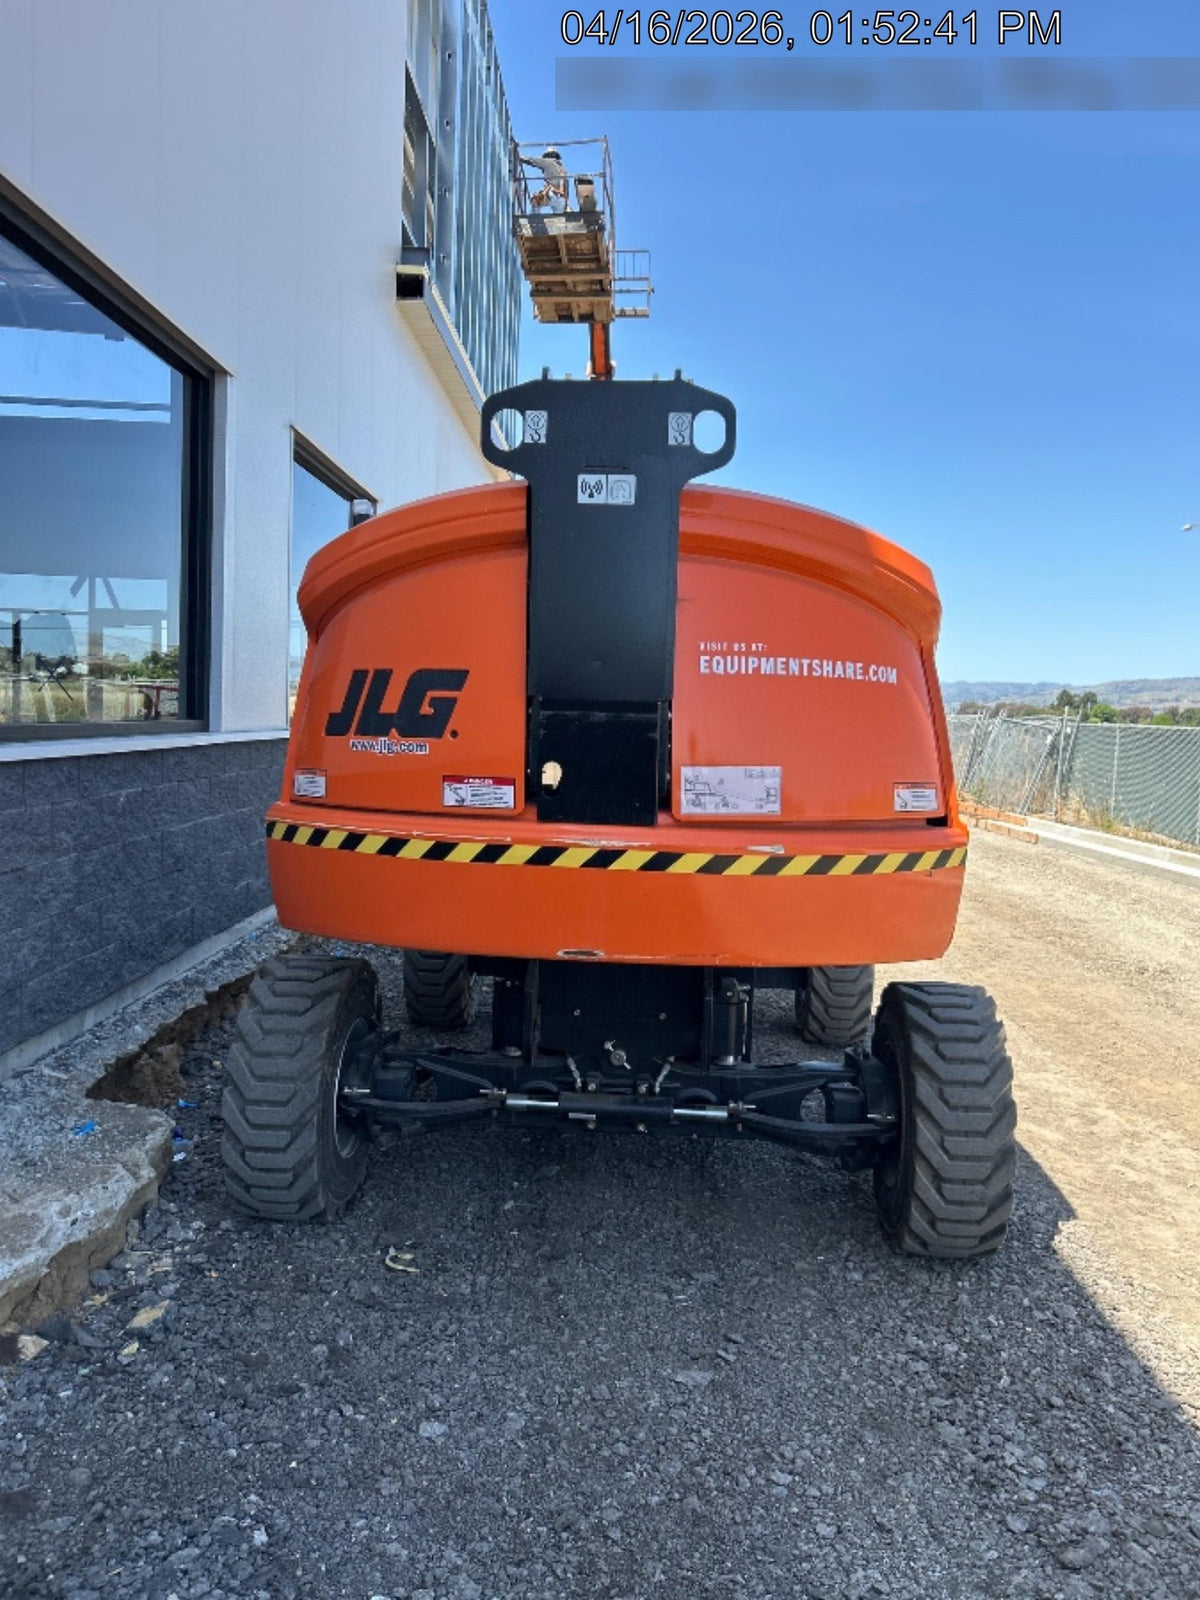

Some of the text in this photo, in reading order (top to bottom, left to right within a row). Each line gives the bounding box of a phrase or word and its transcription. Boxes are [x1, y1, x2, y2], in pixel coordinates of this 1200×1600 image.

[699, 654, 898, 685] EQUIPMENTSHARE.COM
[325, 668, 470, 738] JLG
[351, 738, 429, 756] www.jlg.com
